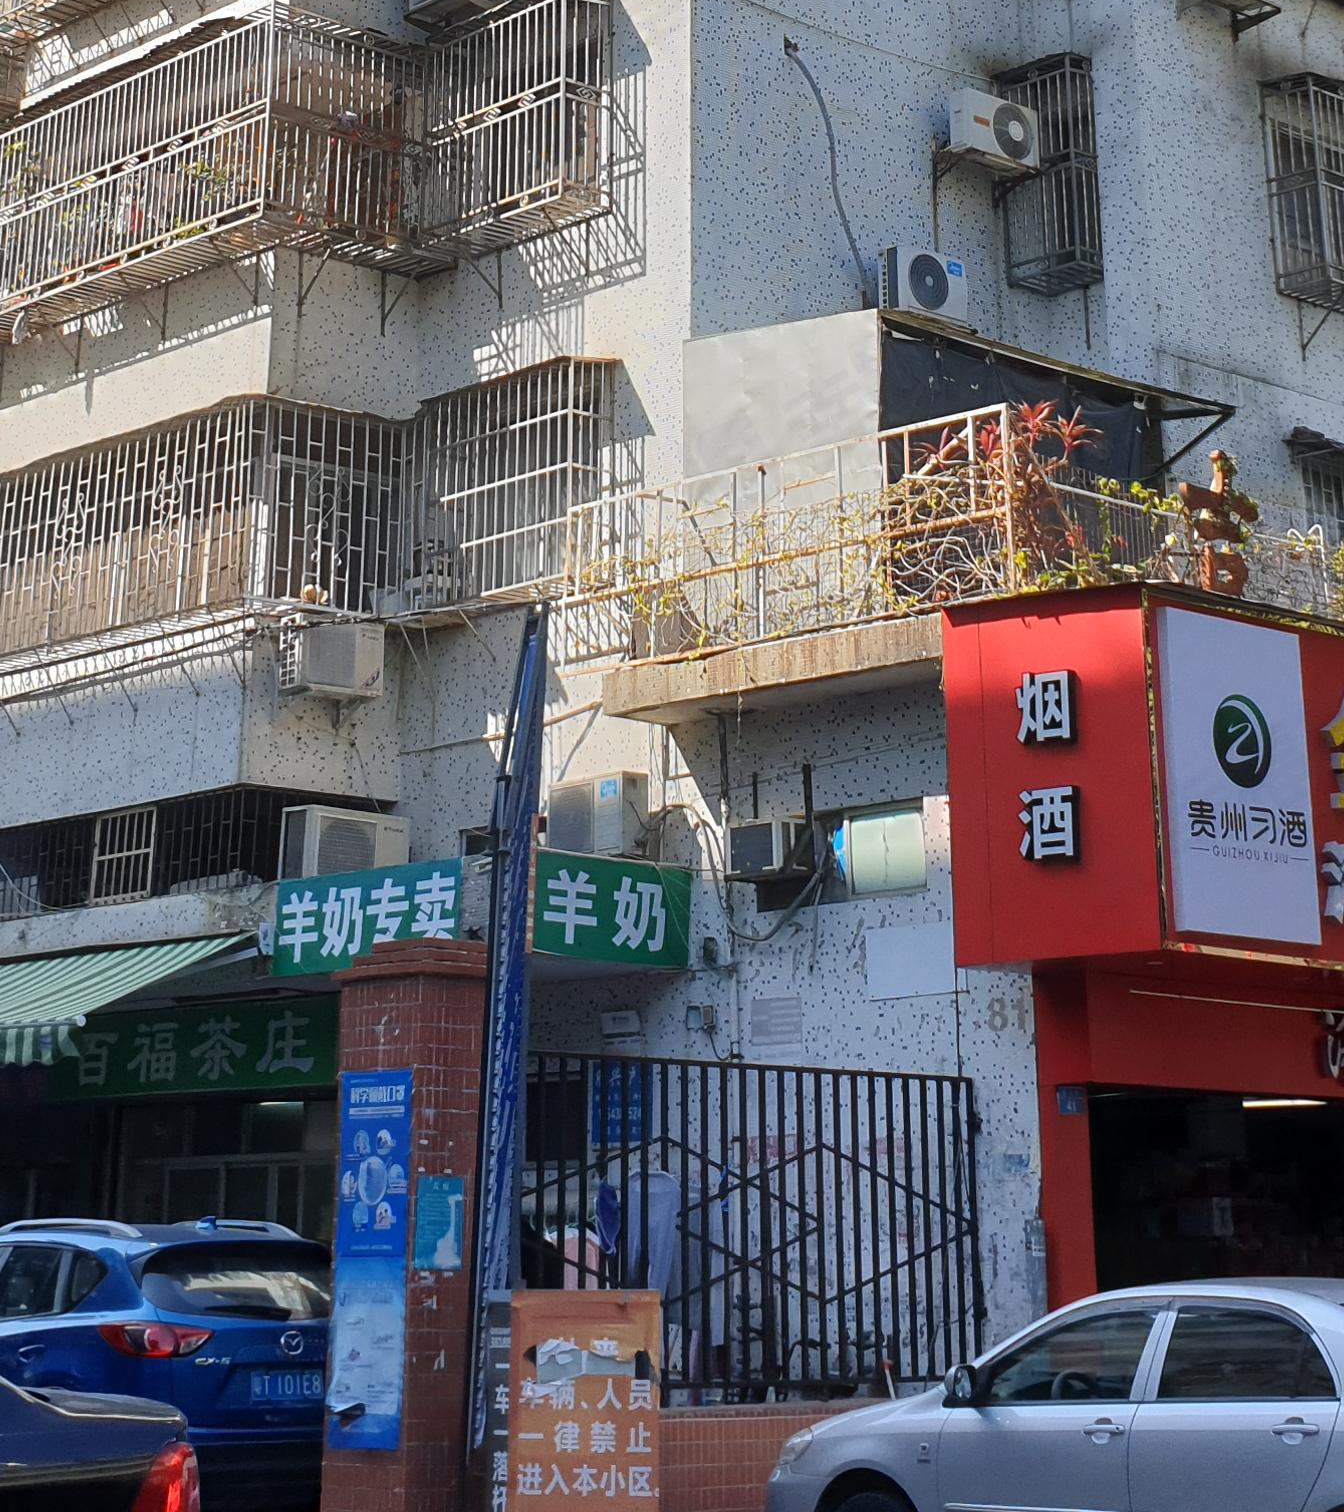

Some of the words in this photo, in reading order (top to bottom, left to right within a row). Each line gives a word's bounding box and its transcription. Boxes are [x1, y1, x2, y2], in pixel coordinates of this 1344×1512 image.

[1016, 669, 1077, 861] 烟酒
[1187, 798, 1308, 848] 贵州习酒
[1212, 844, 1261, 861] GUIZHOU
[278, 871, 456, 964] 羊奶专卖
[542, 868, 667, 953] 羊奶
[77, 1009, 315, 1088] 百福茶庄
[517, 1420, 652, 1454] 一律禁止
